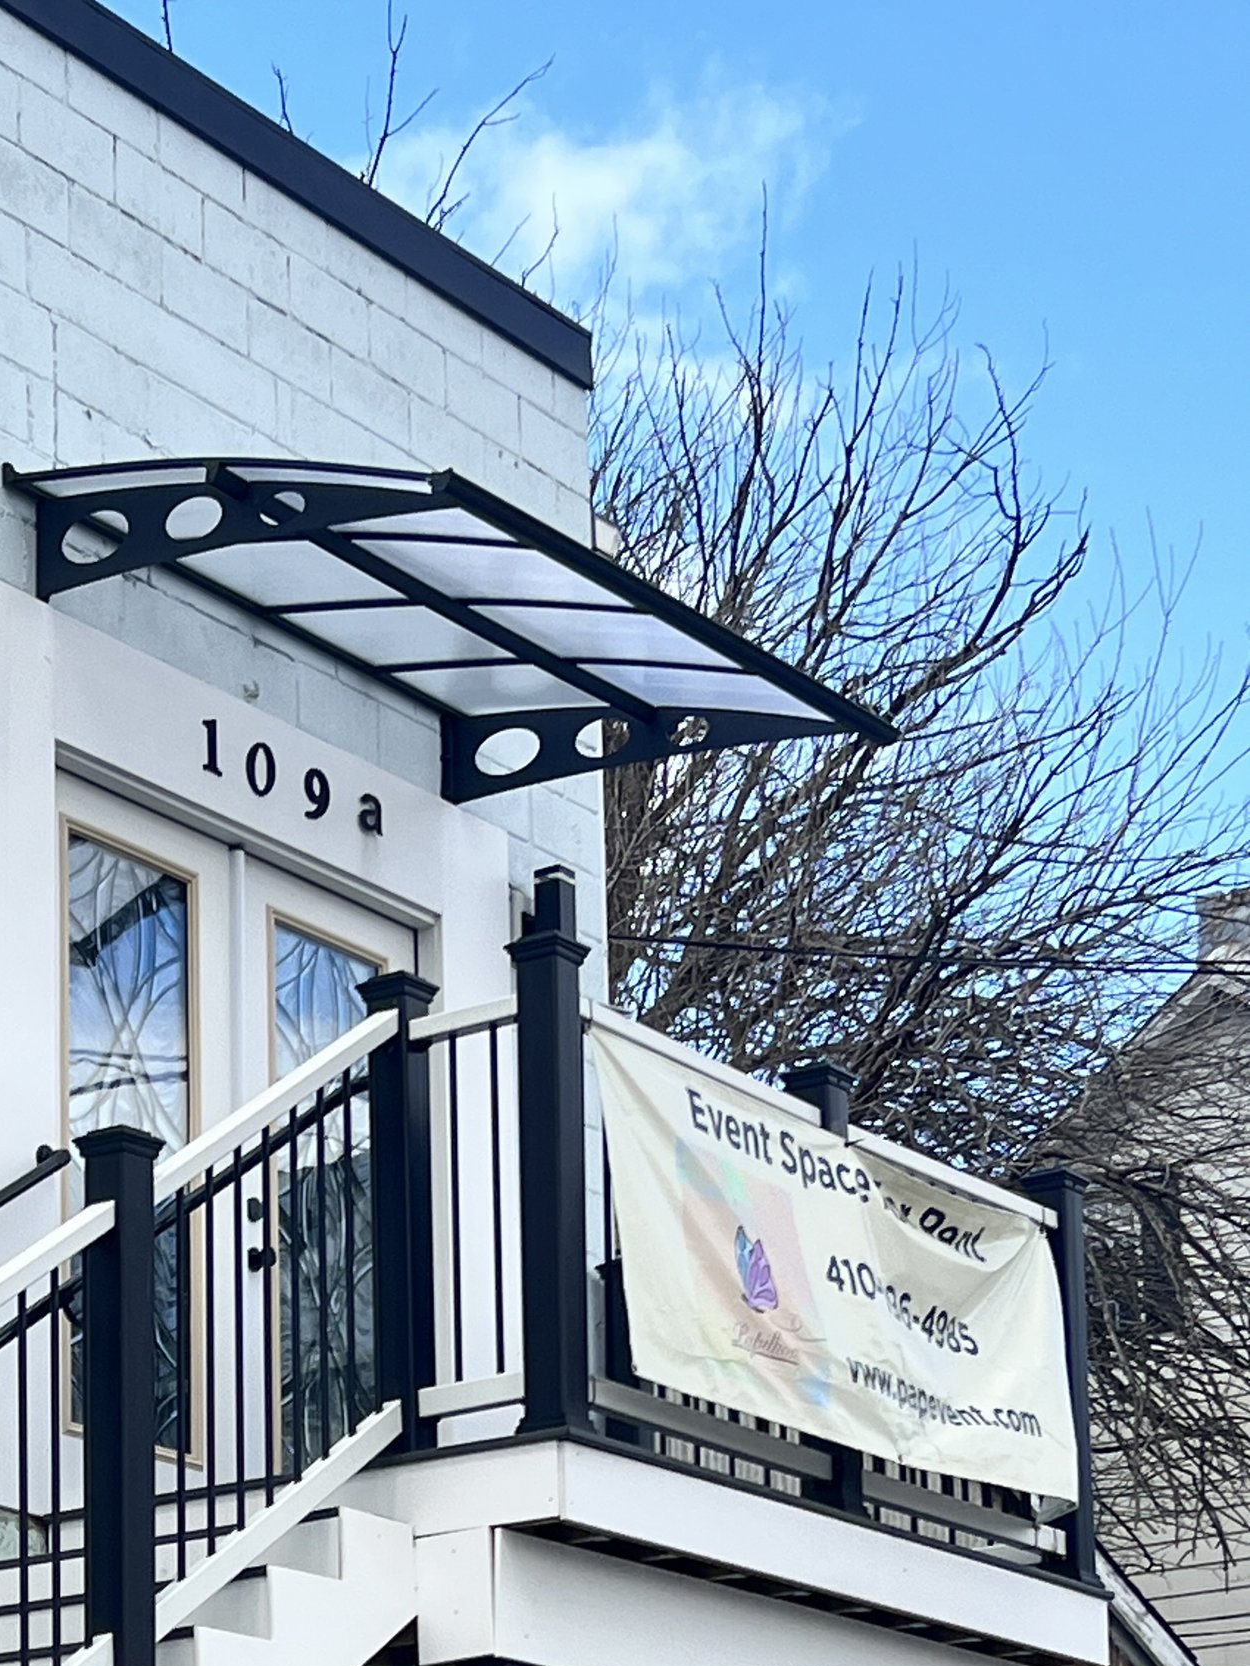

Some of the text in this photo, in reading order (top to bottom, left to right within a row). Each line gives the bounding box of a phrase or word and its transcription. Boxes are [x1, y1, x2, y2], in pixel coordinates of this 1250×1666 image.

[201, 718, 384, 837] 109a
[685, 1086, 773, 1165] Event
[778, 1130, 872, 1204] Space
